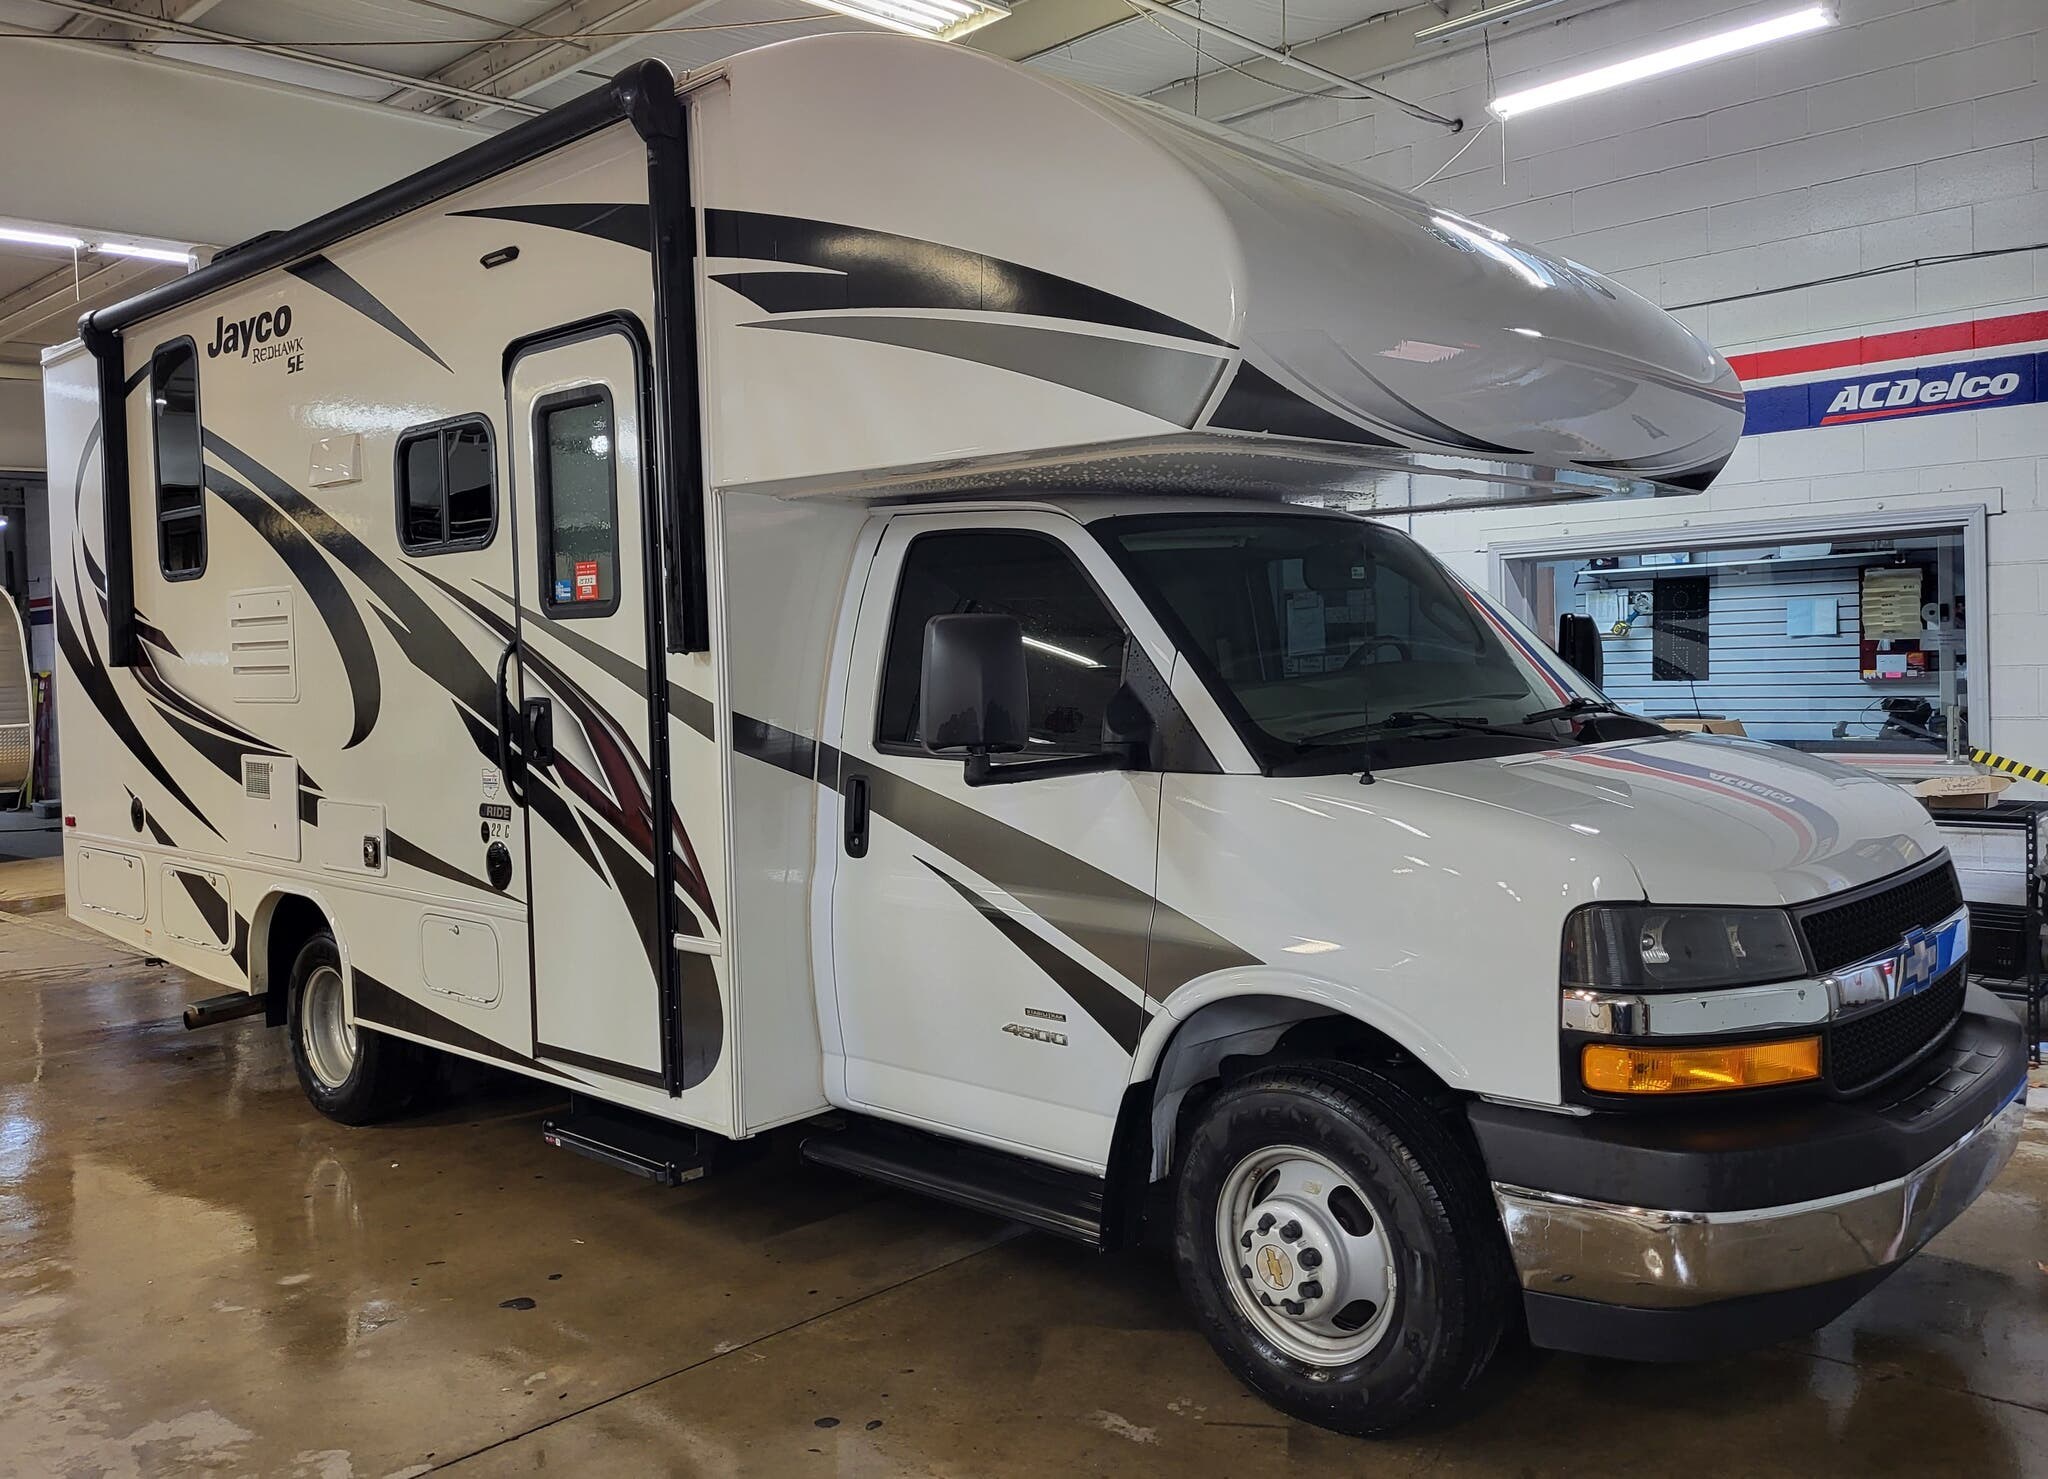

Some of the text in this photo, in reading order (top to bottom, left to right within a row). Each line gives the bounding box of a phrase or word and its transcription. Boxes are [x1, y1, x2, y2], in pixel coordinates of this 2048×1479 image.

[207, 305, 292, 358] Jayco
[287, 353, 304, 375] SE
[1826, 371, 2020, 413] ACDelco
[491, 822, 501, 838] 22
[1002, 1023, 1068, 1047] 4500
